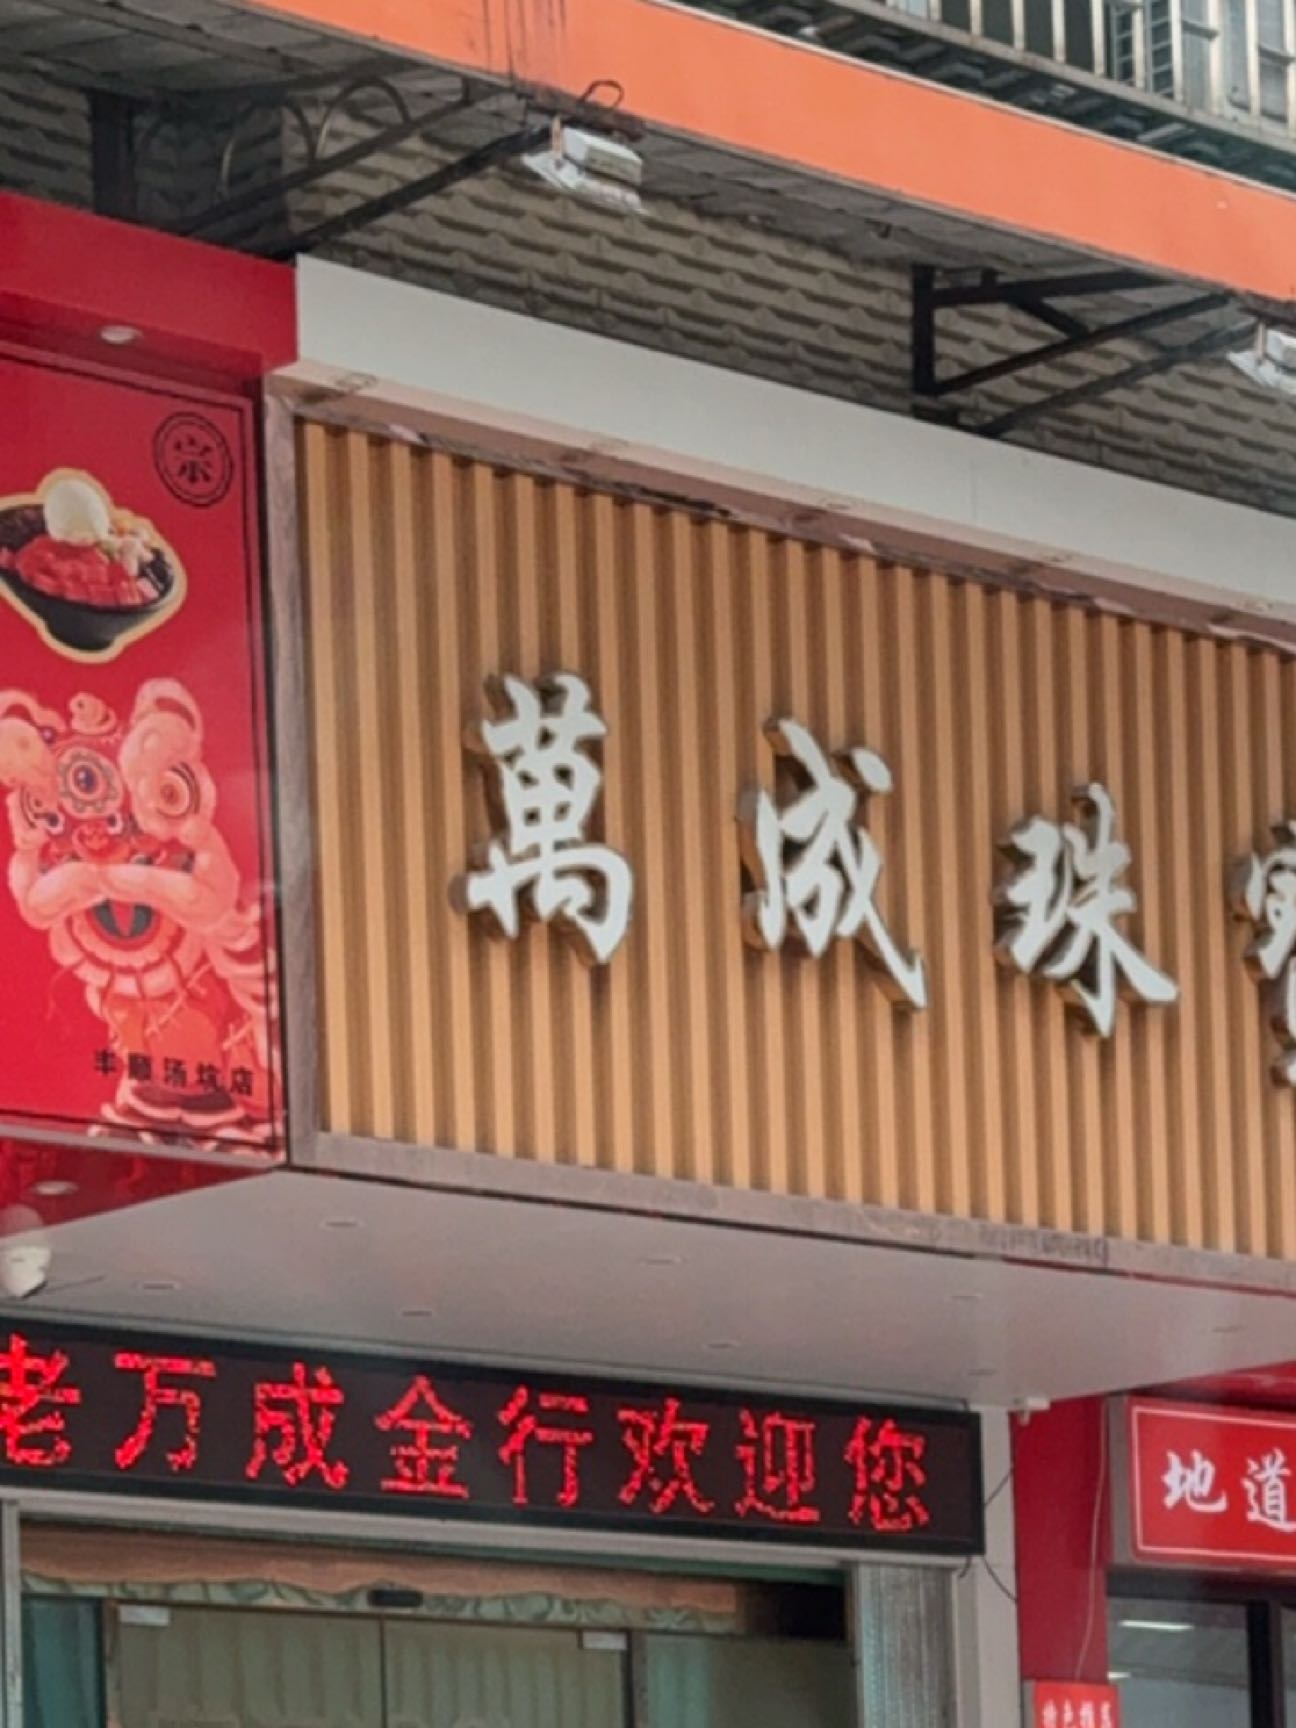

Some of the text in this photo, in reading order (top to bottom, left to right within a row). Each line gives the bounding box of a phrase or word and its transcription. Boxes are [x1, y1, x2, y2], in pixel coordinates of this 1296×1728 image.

[0, 1333, 932, 1533] 老万成金行欢迎您
